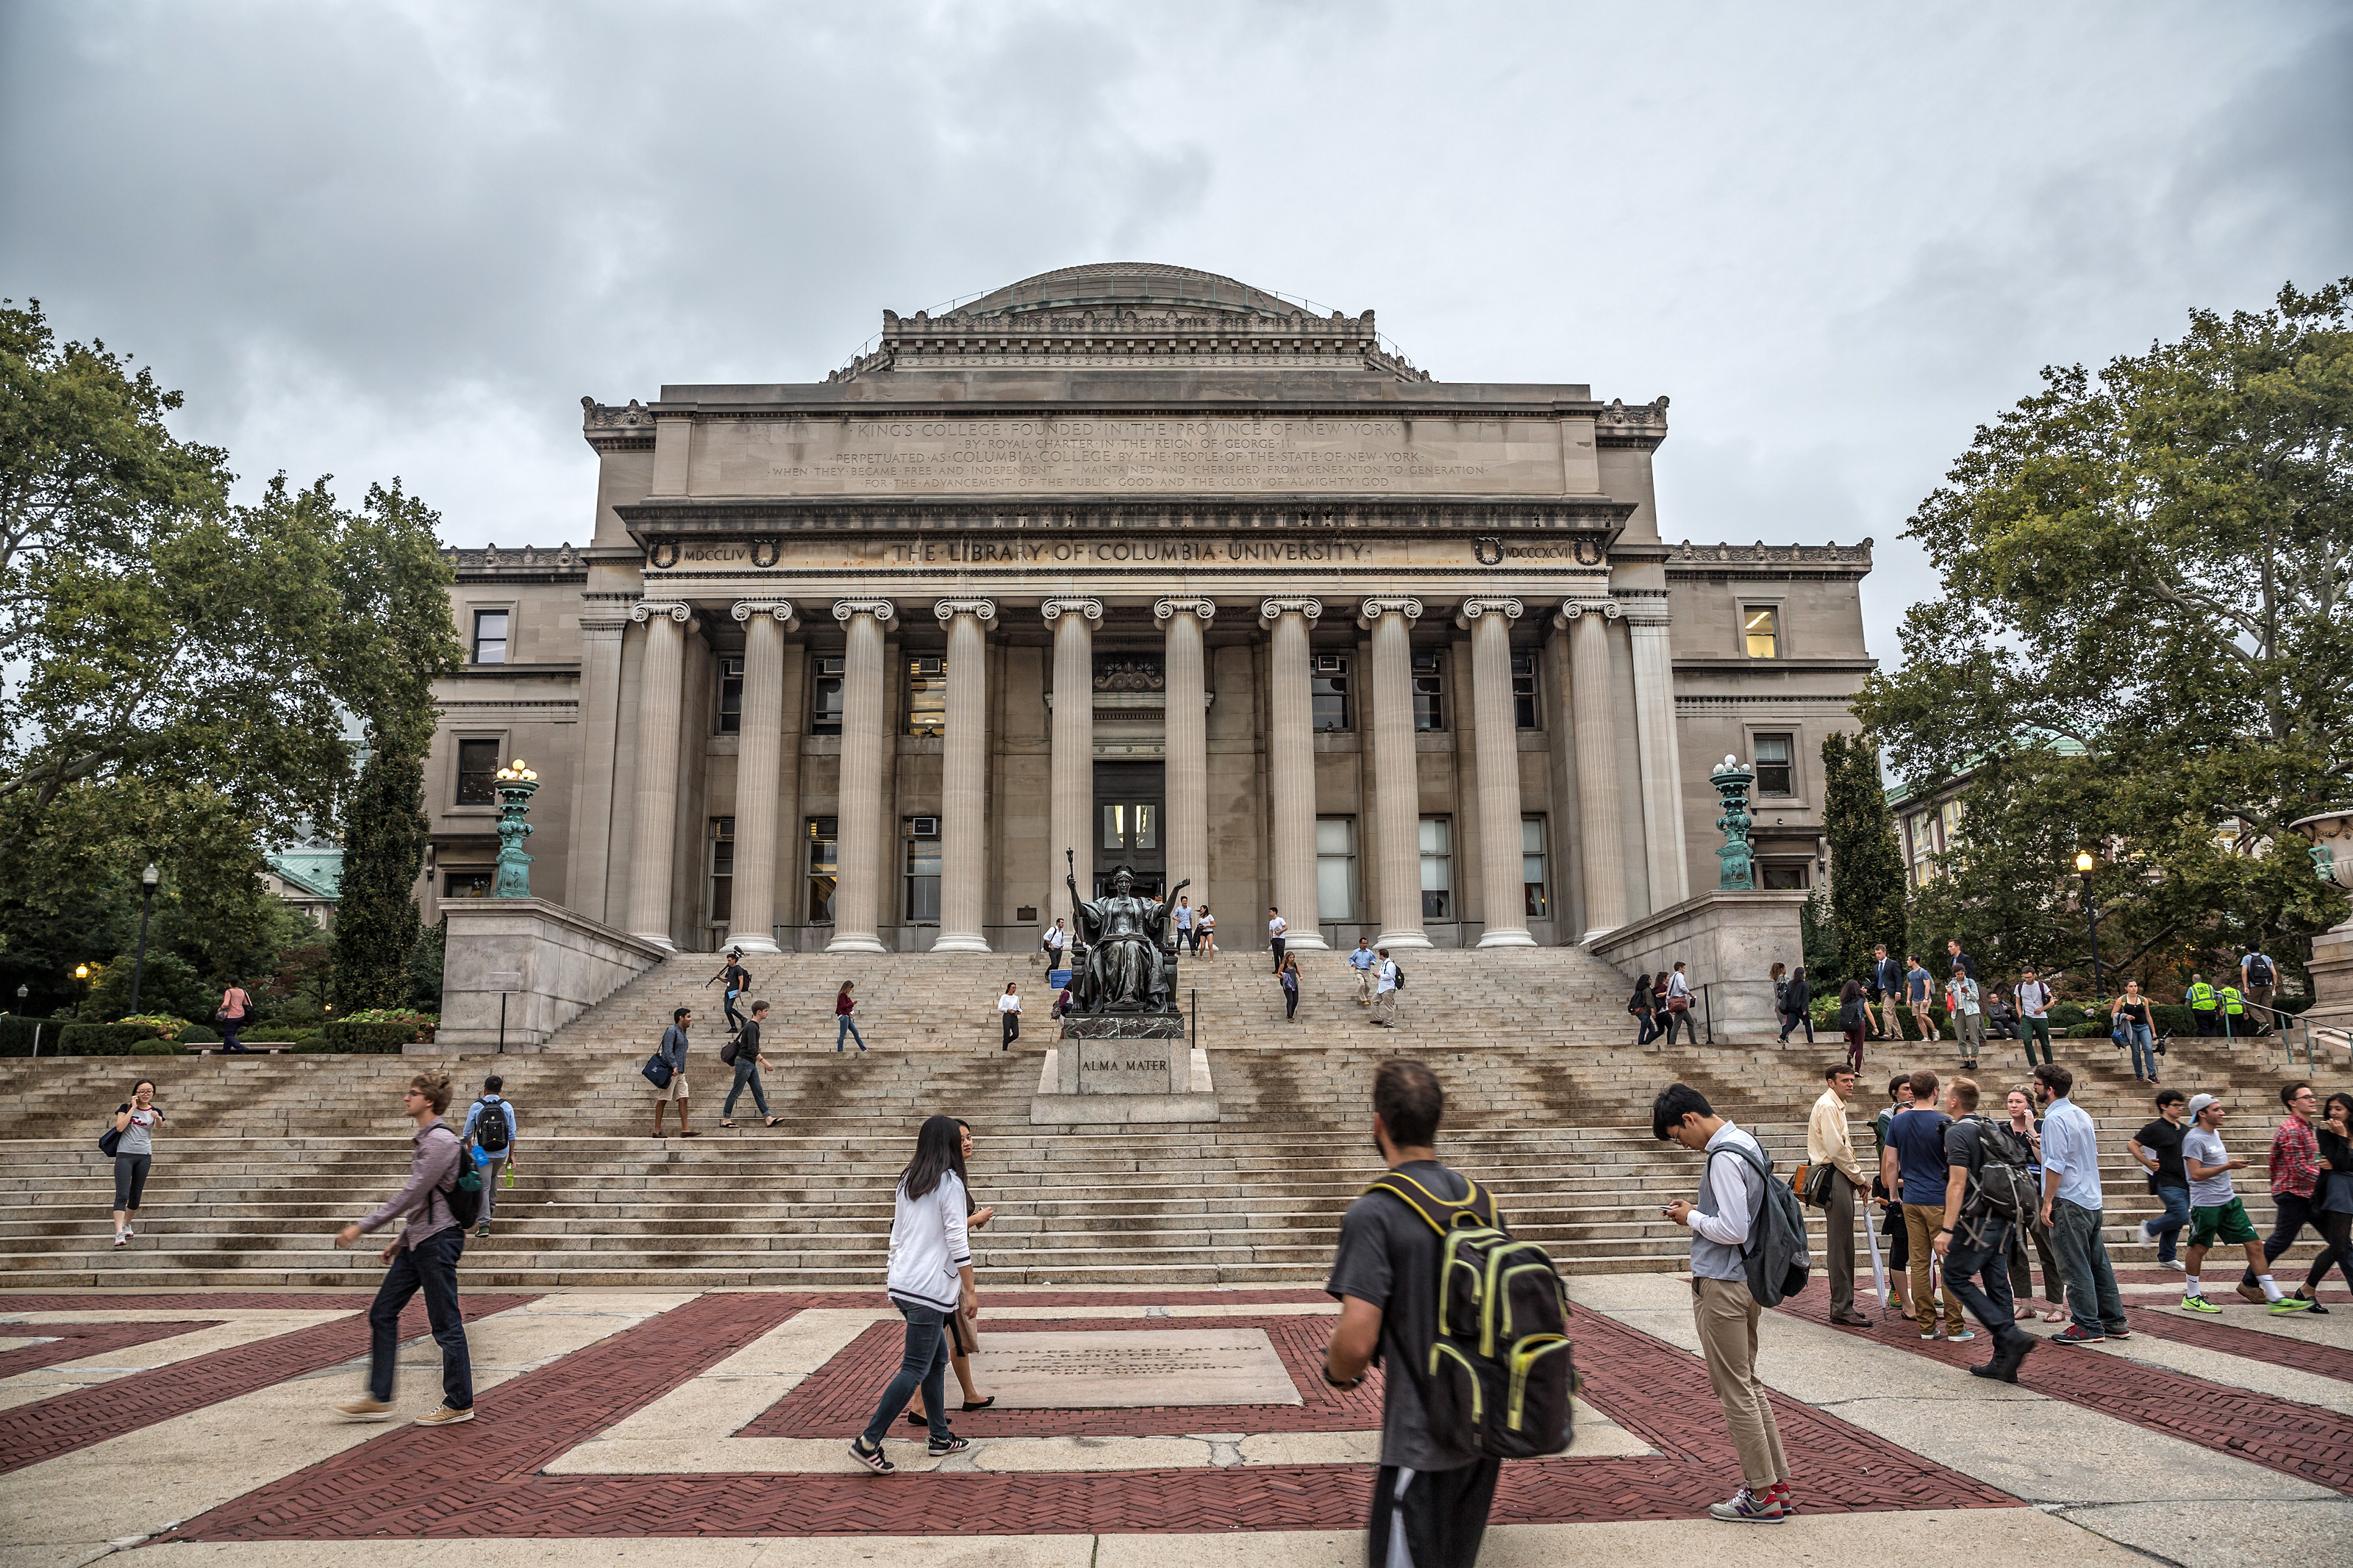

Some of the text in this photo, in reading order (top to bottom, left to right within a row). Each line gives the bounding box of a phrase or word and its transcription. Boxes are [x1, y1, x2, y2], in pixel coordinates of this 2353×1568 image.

[857, 423, 1397, 437] KING'S COLLEGE FOUNDED IN THE PROVINCE OF NEW YORK
[965, 439, 1290, 449] BY ROYAL CHARTER IN THE REIGN OF GEORGE II
[835, 451, 1419, 463] PERPETUATED AS COLUMBIA COLLEGE BY THE PEOPLE OF THE STATE OF NEW YORK
[772, 465, 1484, 476] WHEN THEY BECAME FREE AND INDEPENDENT MAINTAINED AND CHERISHED FROM GENERATION TO GENERATION
[865, 478, 1390, 488] FOR THE ADVANCEMENT OF THE PUBLIC GOOD AND THE GLORY OF ALMIGHTY GOD
[684, 550, 746, 562] MDCCLIV
[892, 543, 1365, 562] THE LIBRARY OF COLUMBIA UNIVERSITY
[1505, 547, 1572, 559] MDCCCXCVII
[1082, 1060, 1168, 1071] ALMA MATER
